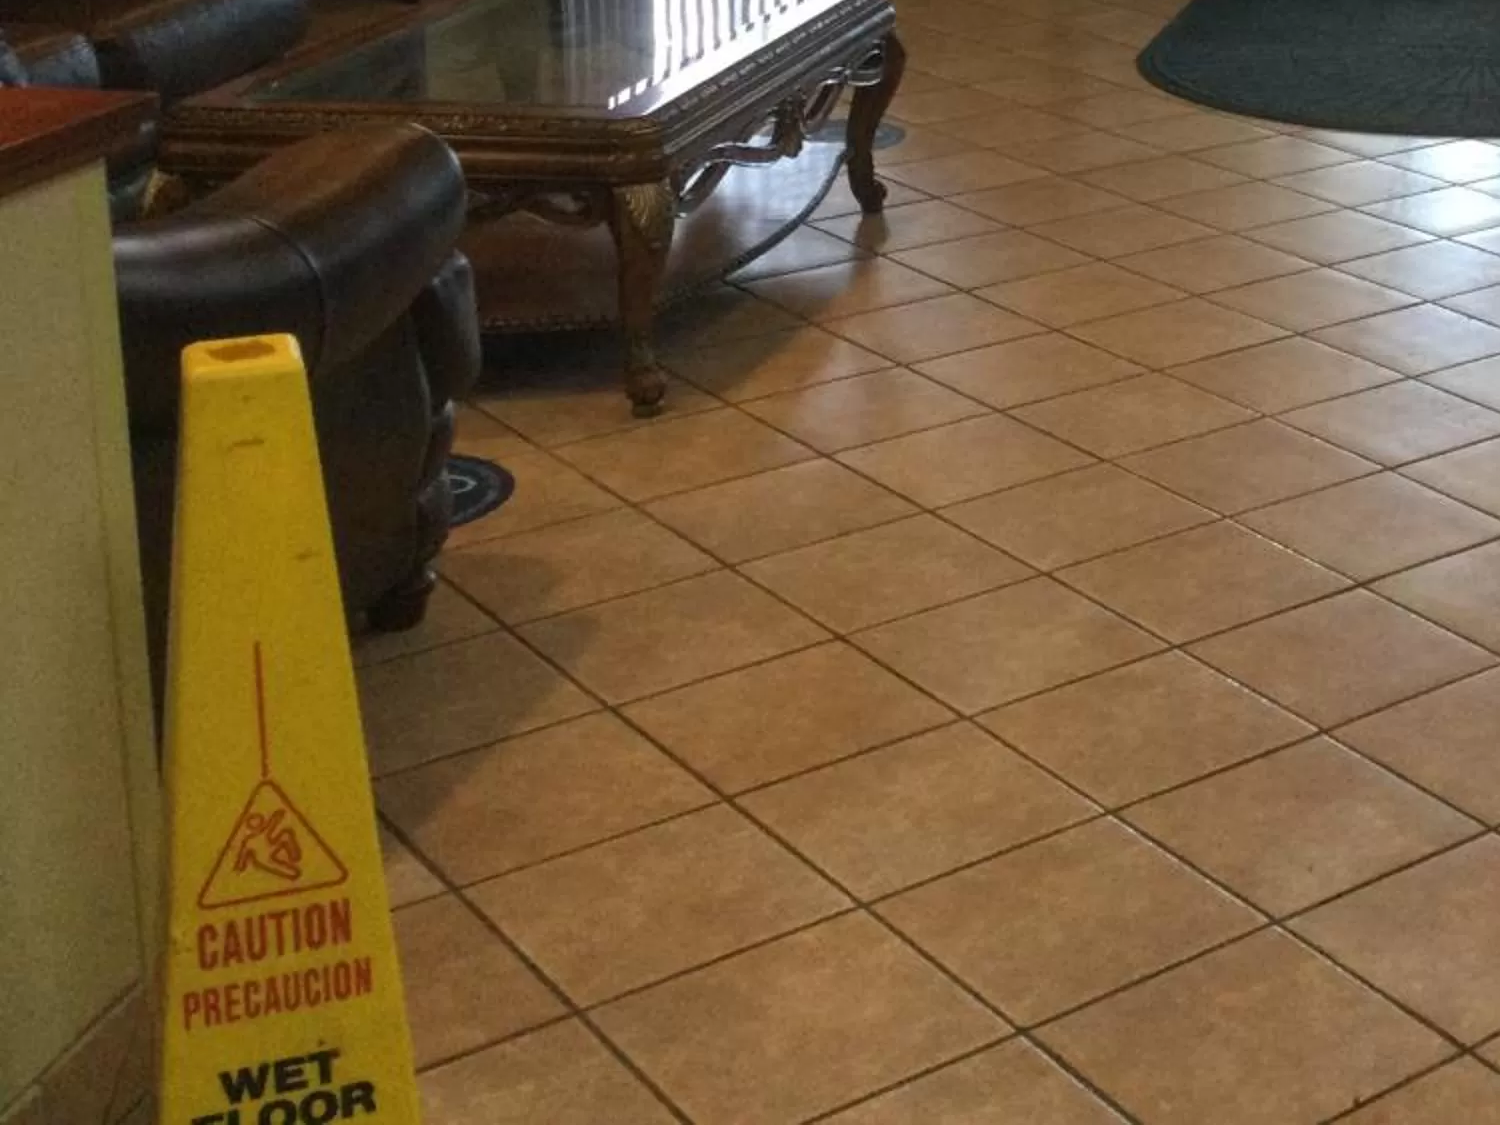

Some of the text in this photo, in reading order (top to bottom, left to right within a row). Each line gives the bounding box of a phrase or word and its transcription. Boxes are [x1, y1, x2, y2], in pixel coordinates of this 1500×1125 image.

[197, 897, 353, 970] CAUTION
[182, 956, 373, 1031] PRECAUCION
[218, 1047, 341, 1105] WET
